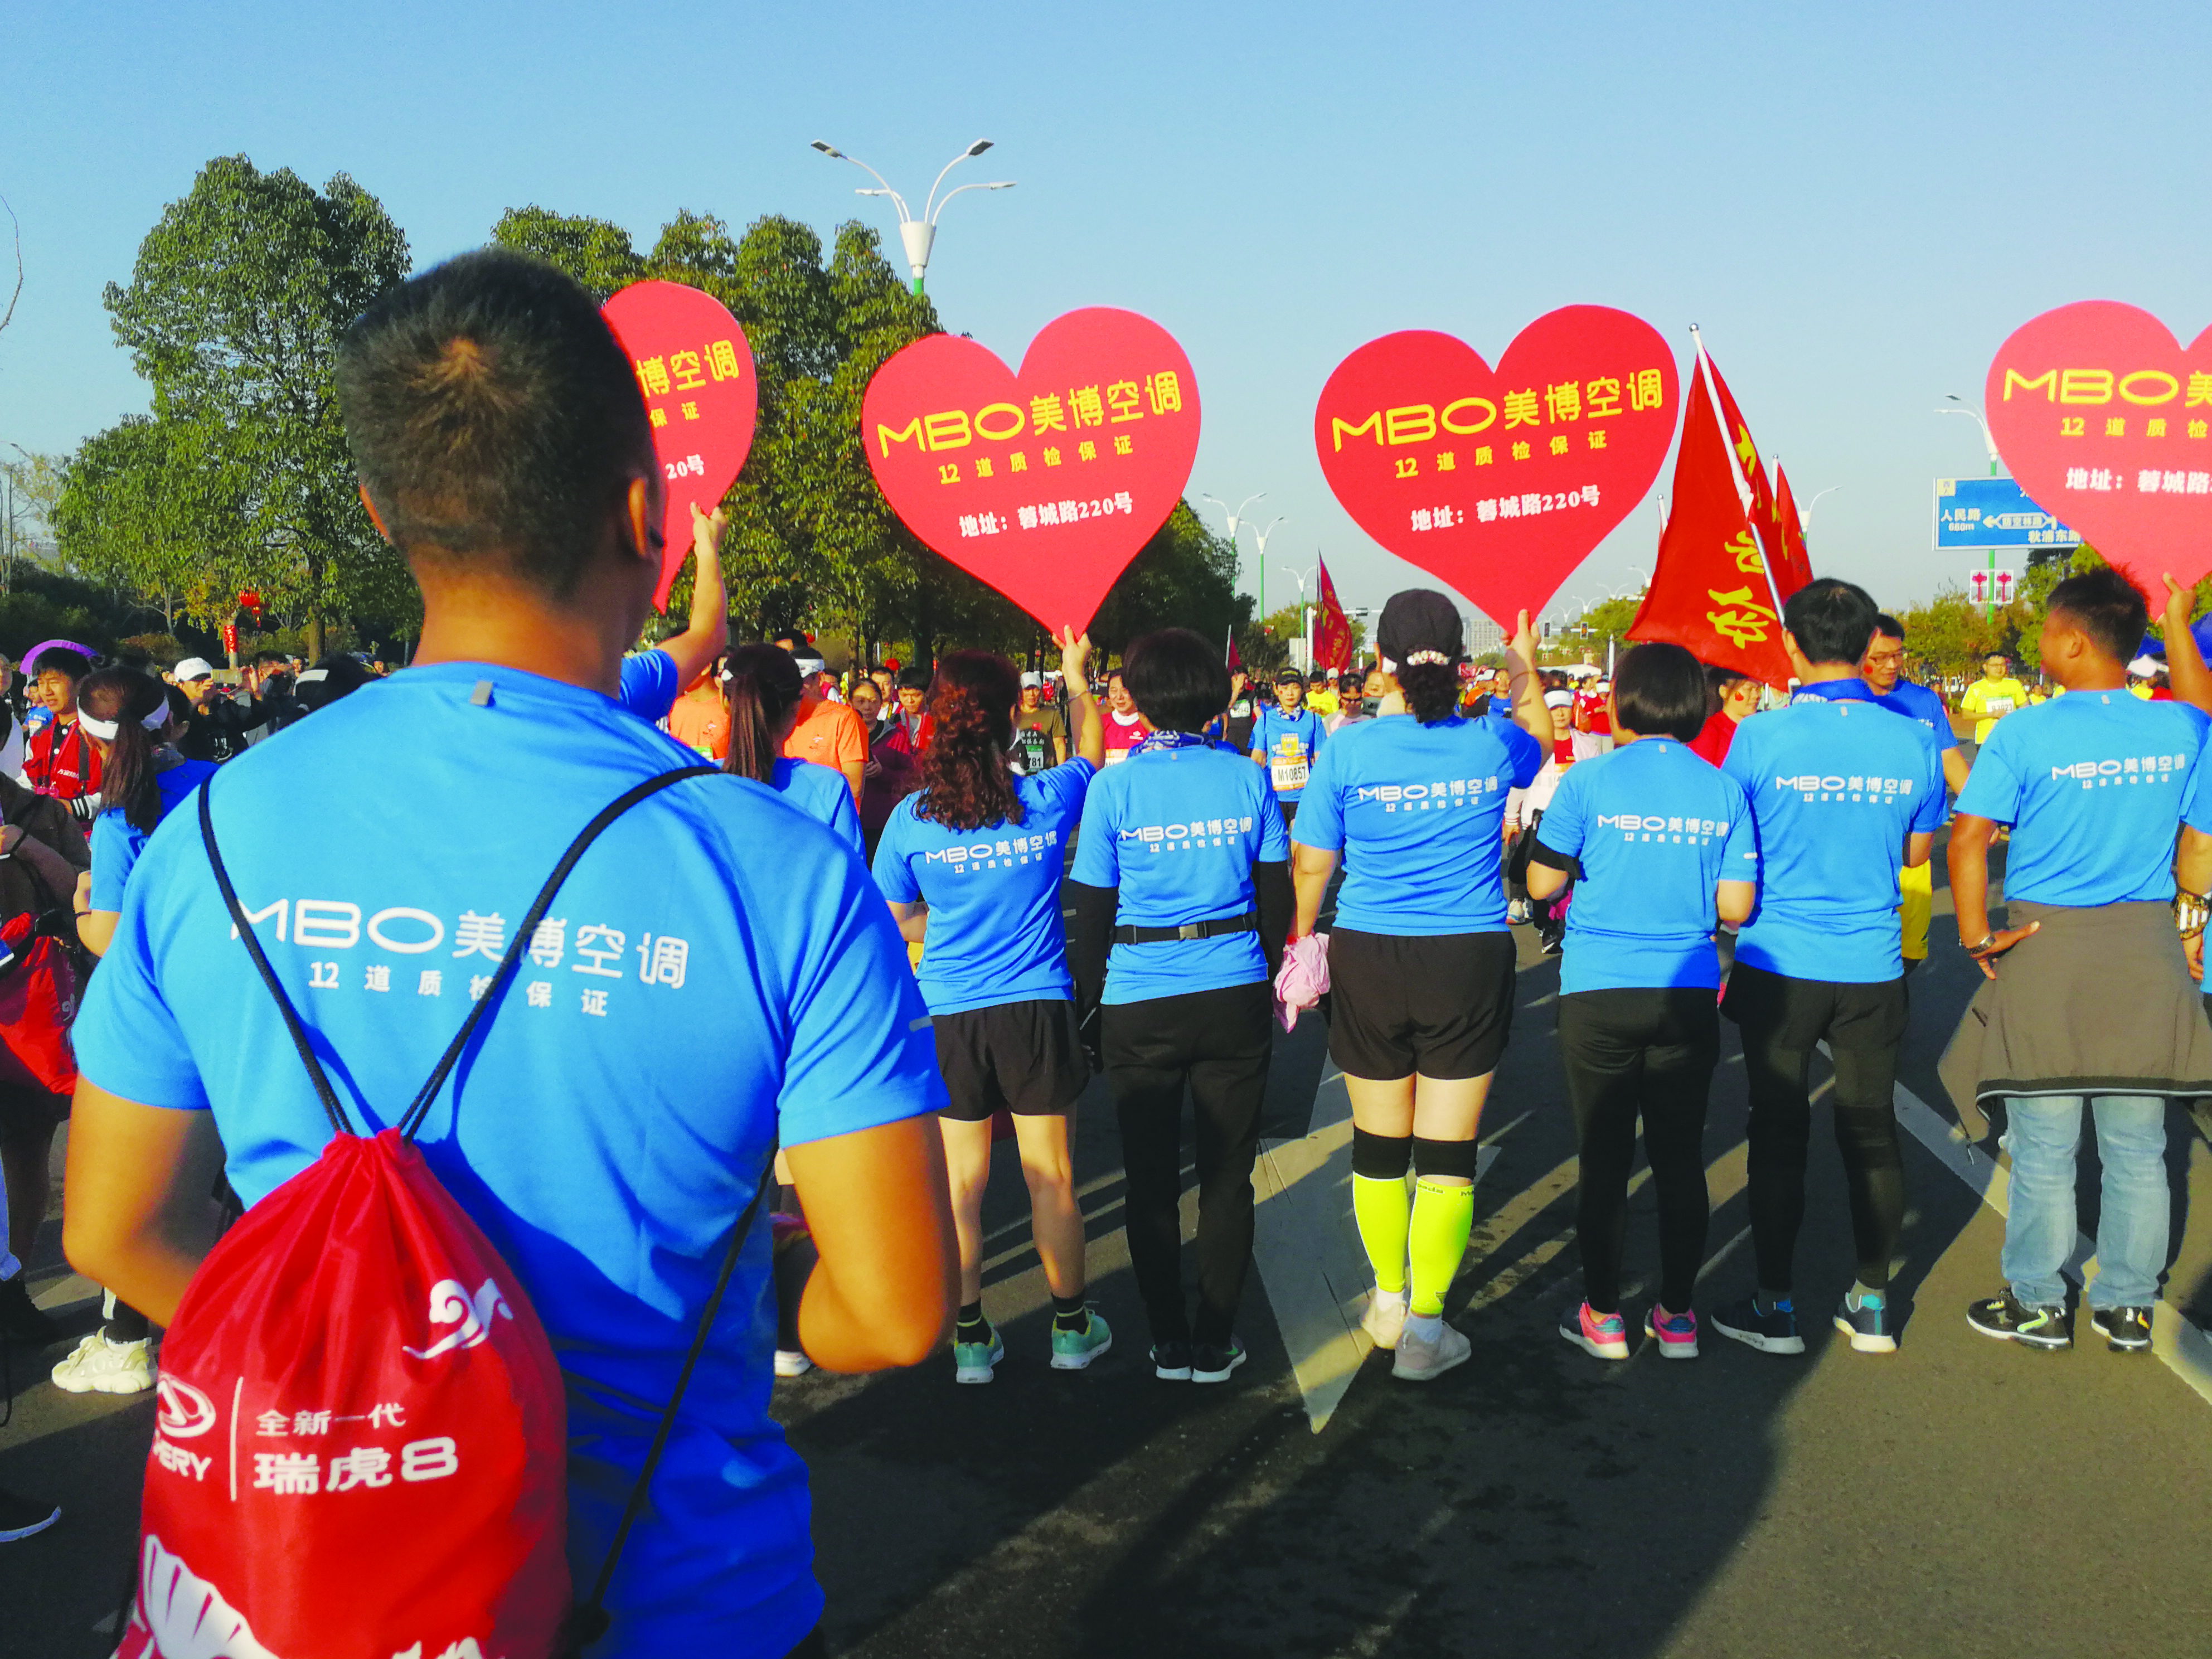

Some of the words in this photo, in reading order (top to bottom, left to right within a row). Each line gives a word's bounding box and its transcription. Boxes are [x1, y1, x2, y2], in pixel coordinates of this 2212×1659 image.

[877, 370, 1182, 459] MBO美博空调
[1332, 368, 1663, 453] MBO美博空调
[1940, 508, 1981, 522] 人民路
[1277, 766, 1306, 782] M10857
[256, 1403, 407, 1437] 全新一代
[253, 1436, 459, 1495] 瑞虎8
